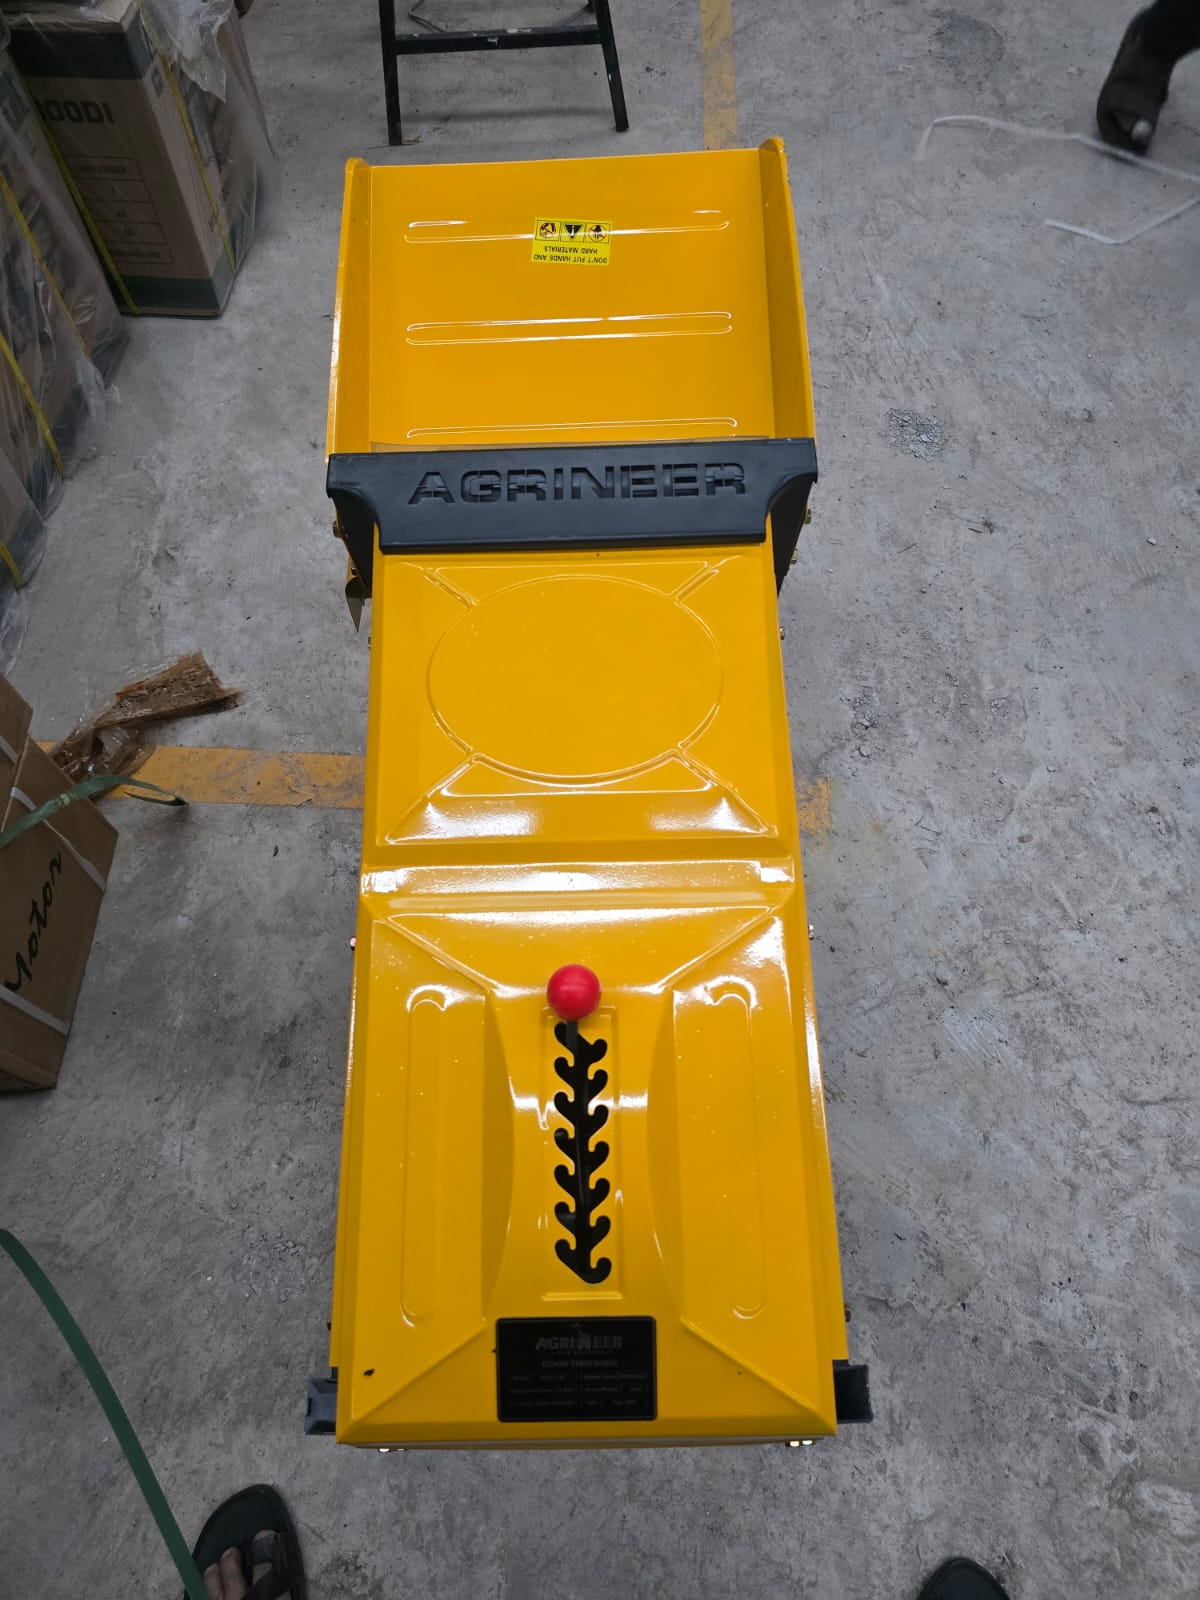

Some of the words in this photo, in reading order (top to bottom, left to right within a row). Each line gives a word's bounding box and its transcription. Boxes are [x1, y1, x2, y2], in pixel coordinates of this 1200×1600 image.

[543, 246, 578, 254] MATERIALS
[533, 253, 547, 261] AND
[407, 462, 748, 505] AGRINEER
[535, 1333, 623, 1351] AGRINEER
